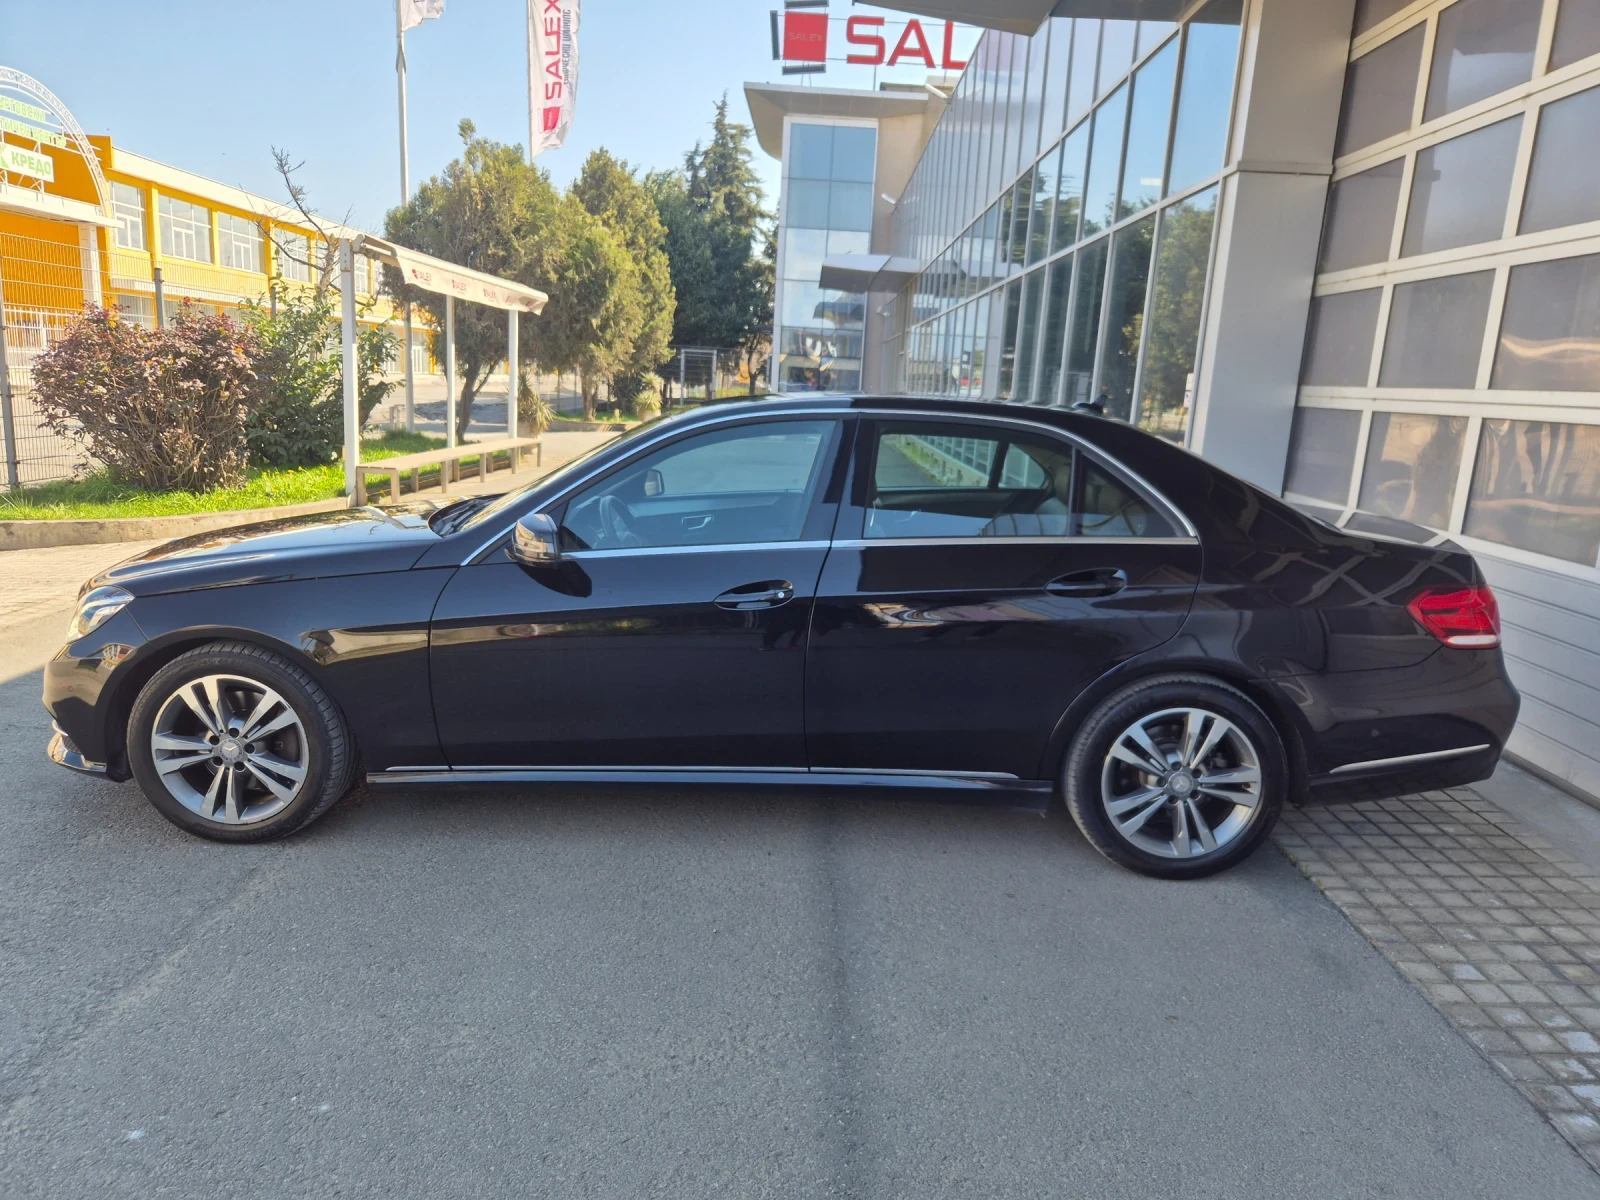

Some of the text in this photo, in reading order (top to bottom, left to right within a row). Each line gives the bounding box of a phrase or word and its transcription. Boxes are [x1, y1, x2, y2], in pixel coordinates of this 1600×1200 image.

[544, 0, 563, 100] SALEX
[788, 32, 824, 43] SALEX
[846, 15, 967, 70] SAL
[11, 150, 52, 176] КРЕДО
